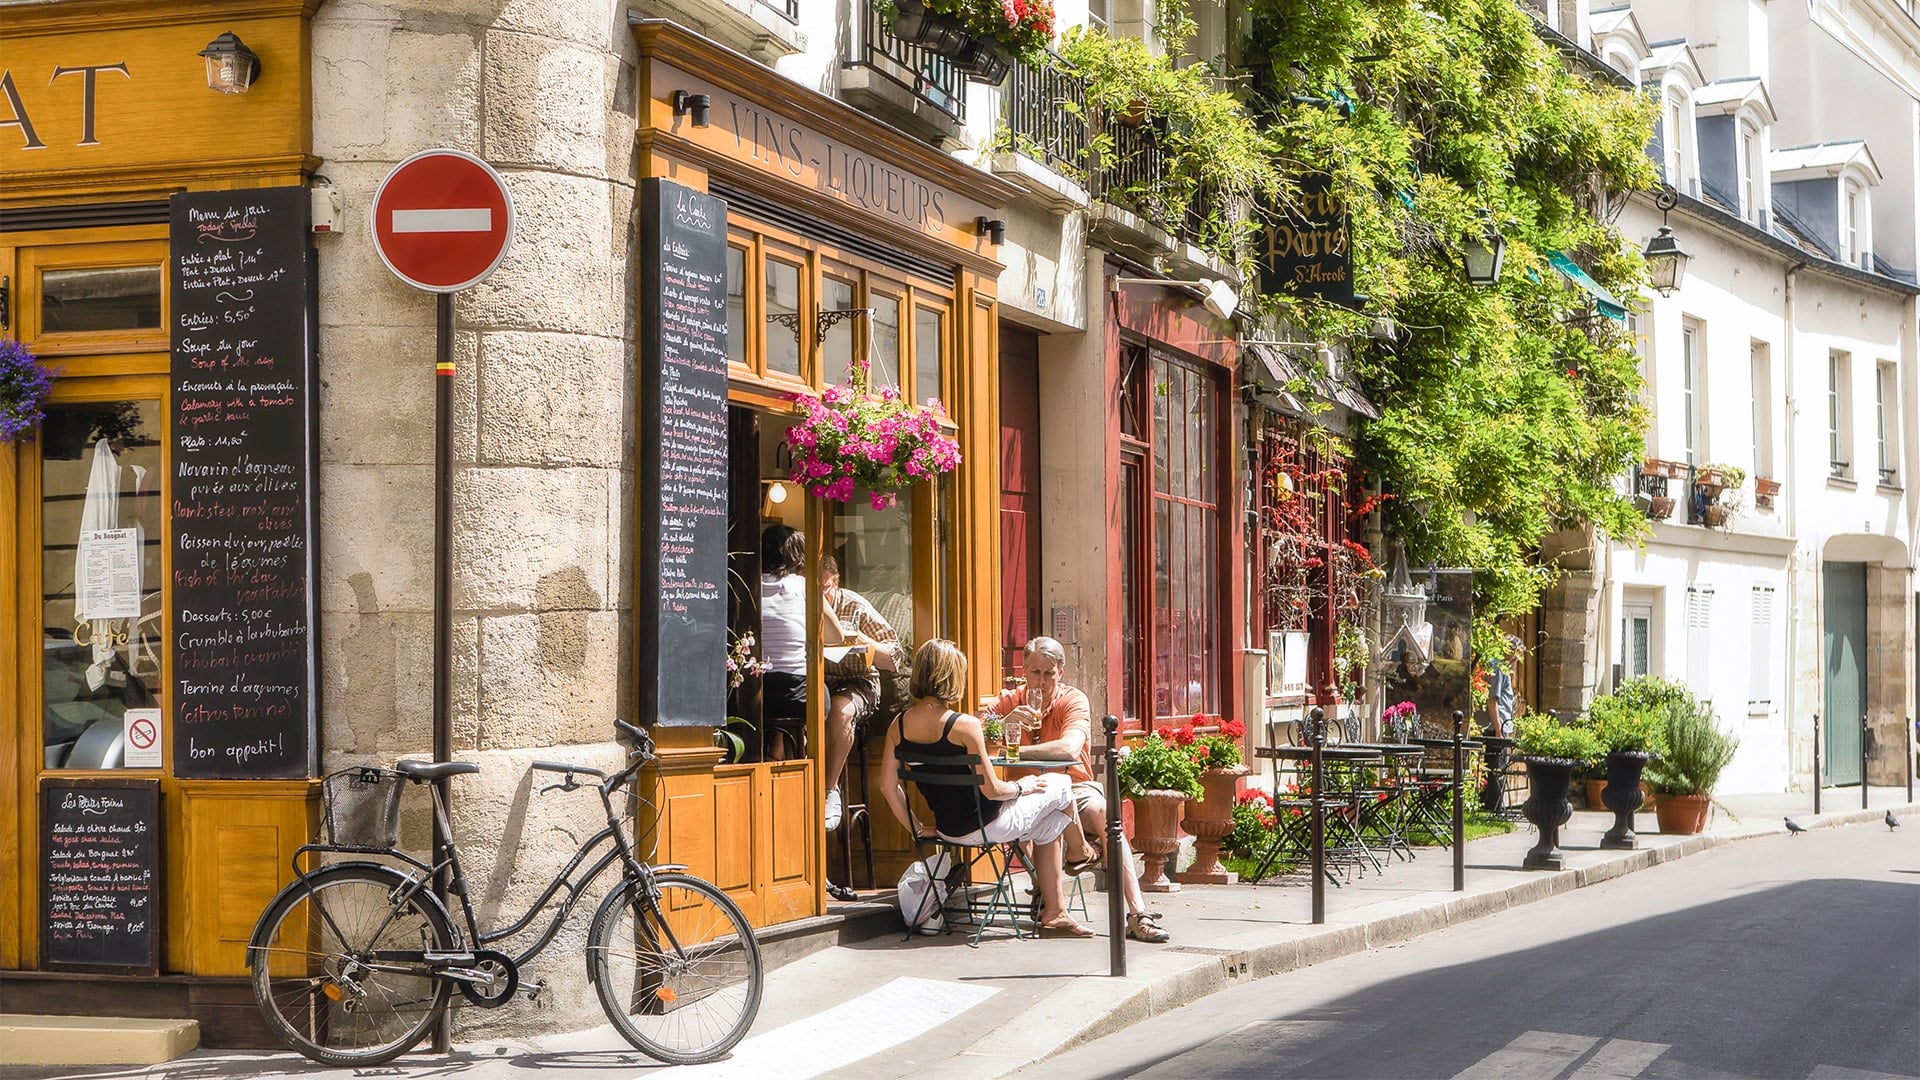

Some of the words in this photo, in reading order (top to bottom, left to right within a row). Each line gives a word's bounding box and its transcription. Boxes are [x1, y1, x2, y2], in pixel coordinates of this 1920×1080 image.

[728, 100, 804, 177] VINS
[826, 143, 946, 233] LIQUEURS
[188, 207, 220, 222] Menu
[223, 206, 241, 220] du
[1261, 225, 1347, 274] Paris
[178, 461, 229, 478] Navarin
[255, 476, 297, 493] olives
[180, 532, 222, 550] Poisson
[200, 551, 218, 568] de
[224, 551, 288, 576] légumes
[178, 629, 233, 651] Crumble
[180, 679, 225, 696] Terrine
[229, 672, 299, 702] d'agrumes
[190, 737, 216, 760] bon
